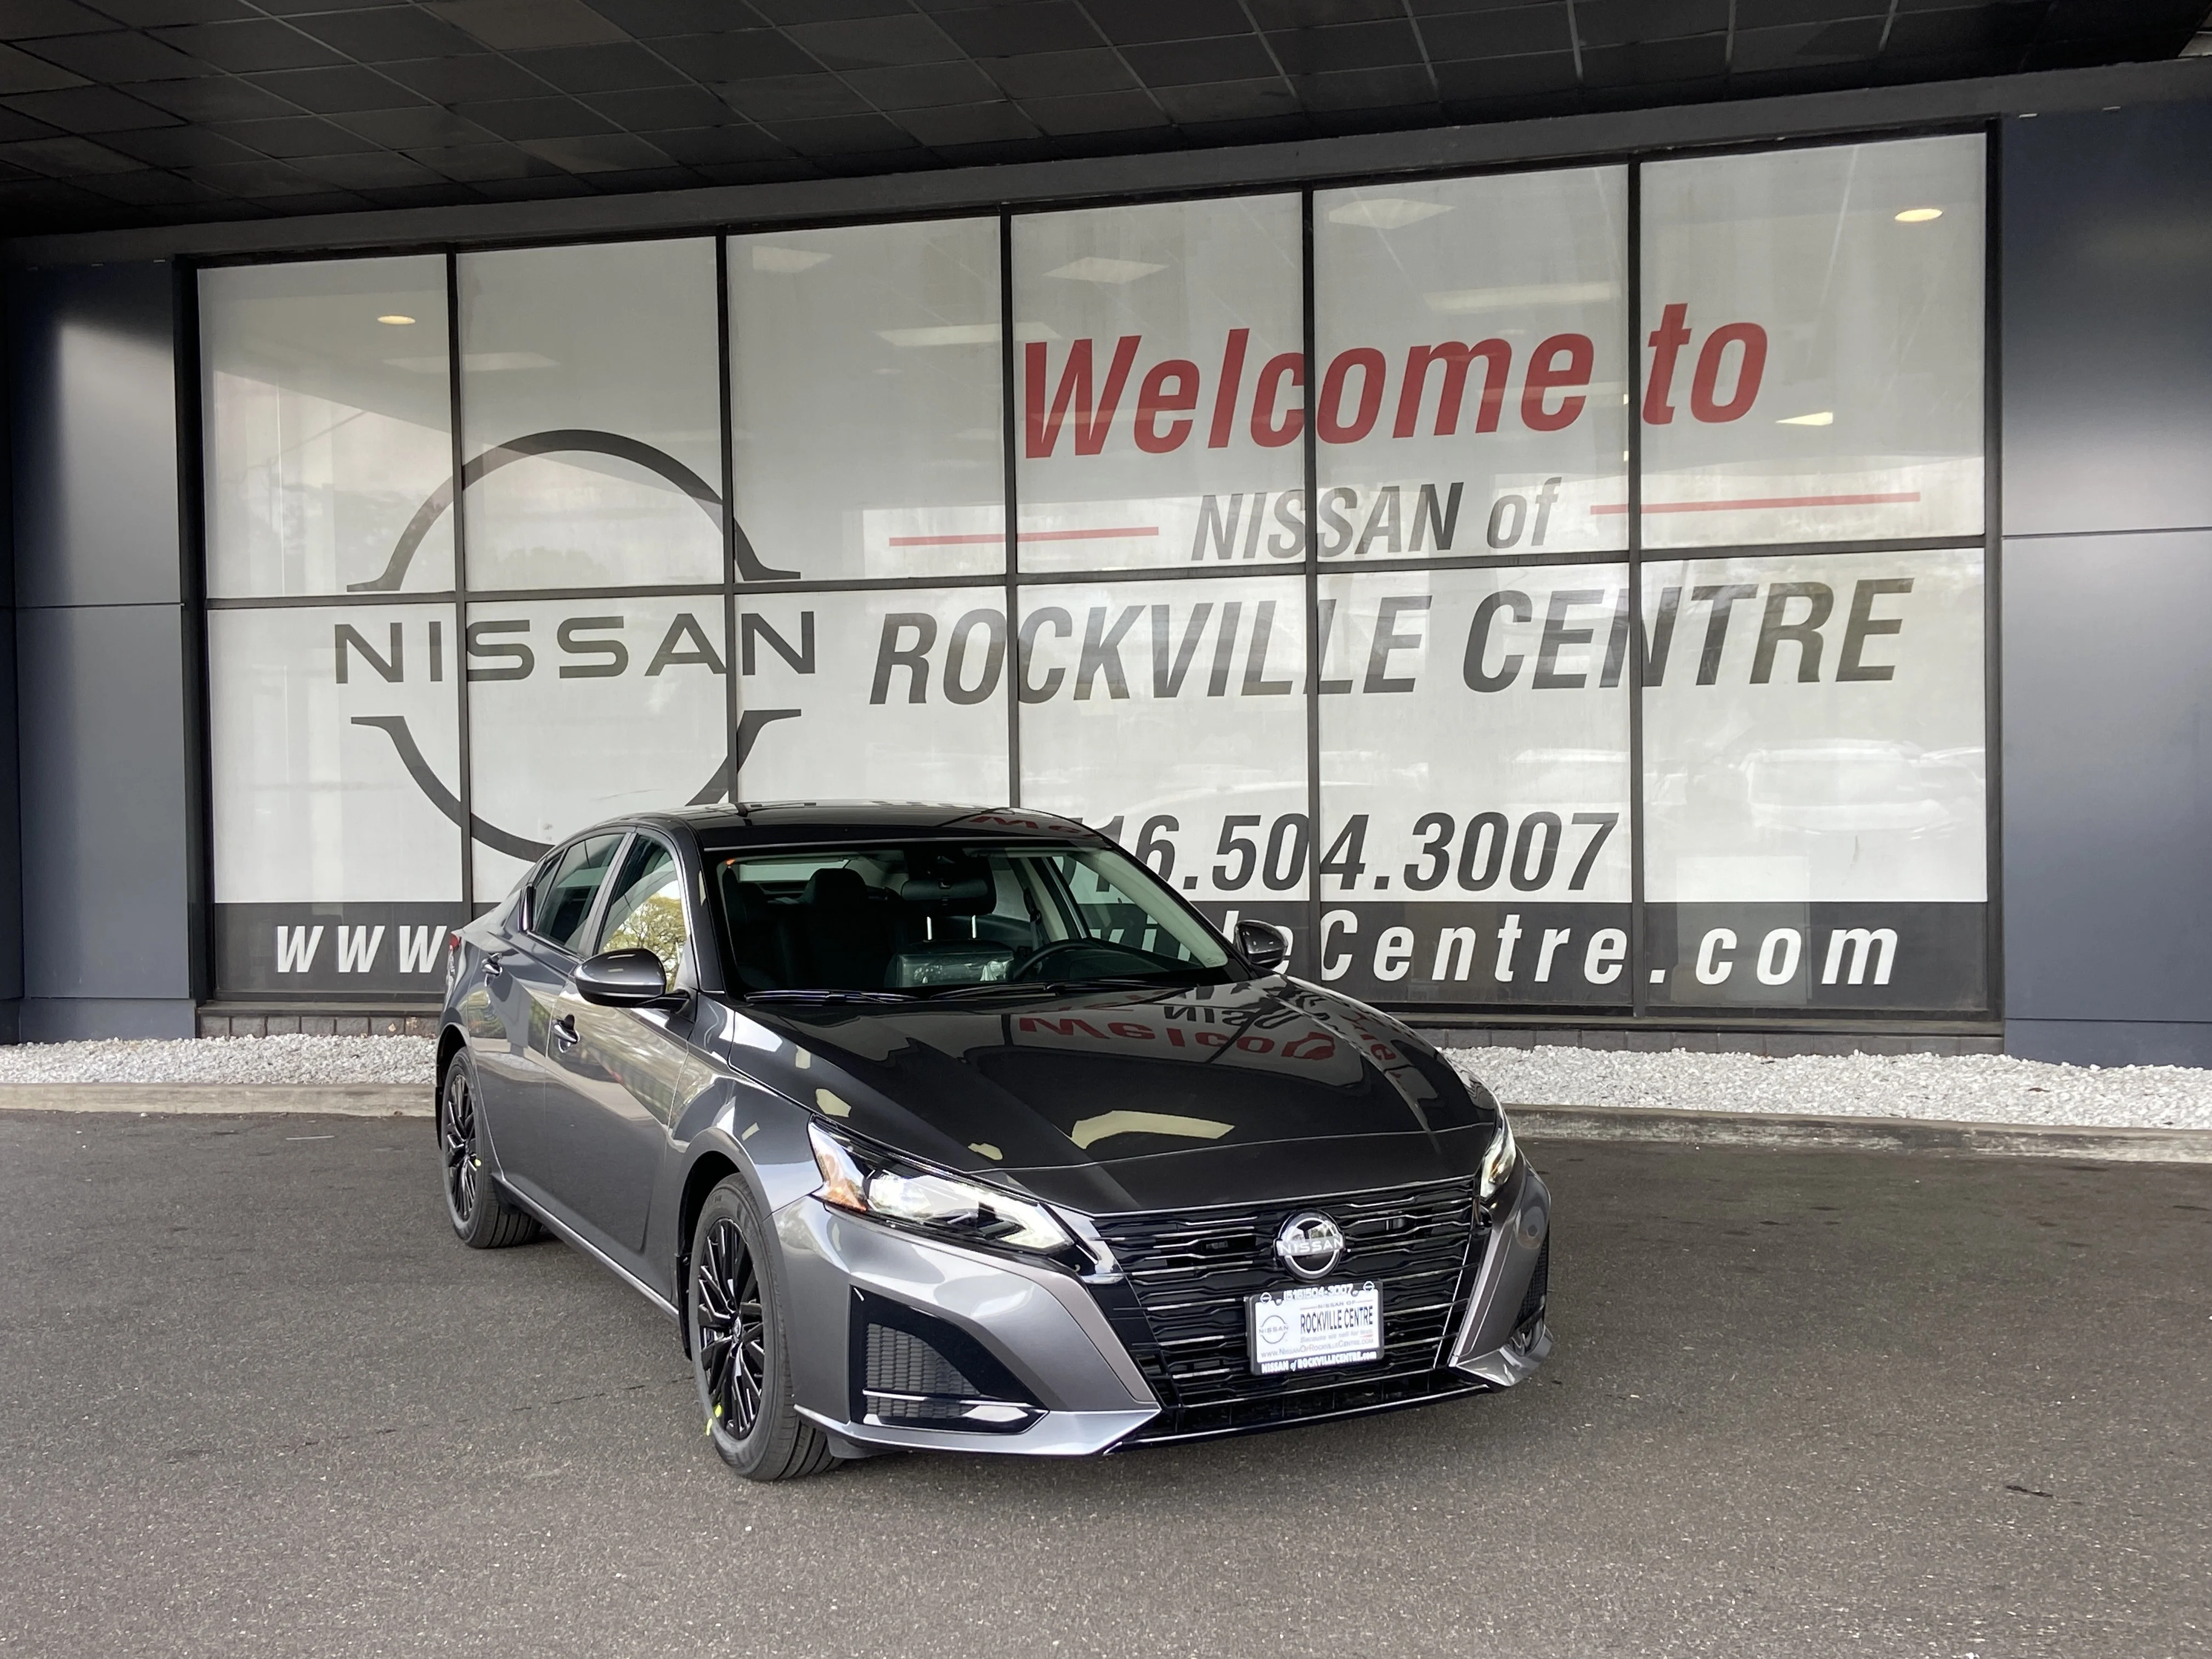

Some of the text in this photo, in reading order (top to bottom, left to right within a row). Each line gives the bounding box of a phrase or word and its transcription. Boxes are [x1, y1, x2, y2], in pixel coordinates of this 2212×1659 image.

[1025, 303, 1768, 459] Welcome to
[1191, 477, 1562, 562] NISSAN of
[334, 610, 815, 684] NISSAN
[869, 579, 1913, 706] ROCKVILLE CENTRE
[1277, 1237, 1344, 1254] NISSAN
[1300, 1305, 1373, 1334] ROCKVILLE CENTRE
[1318, 1301, 1344, 1309] NISSAN
[1259, 1325, 1289, 1334] NISSAN
[1261, 1360, 1289, 1374] NISSAN
[1290, 1359, 1297, 1372] of
